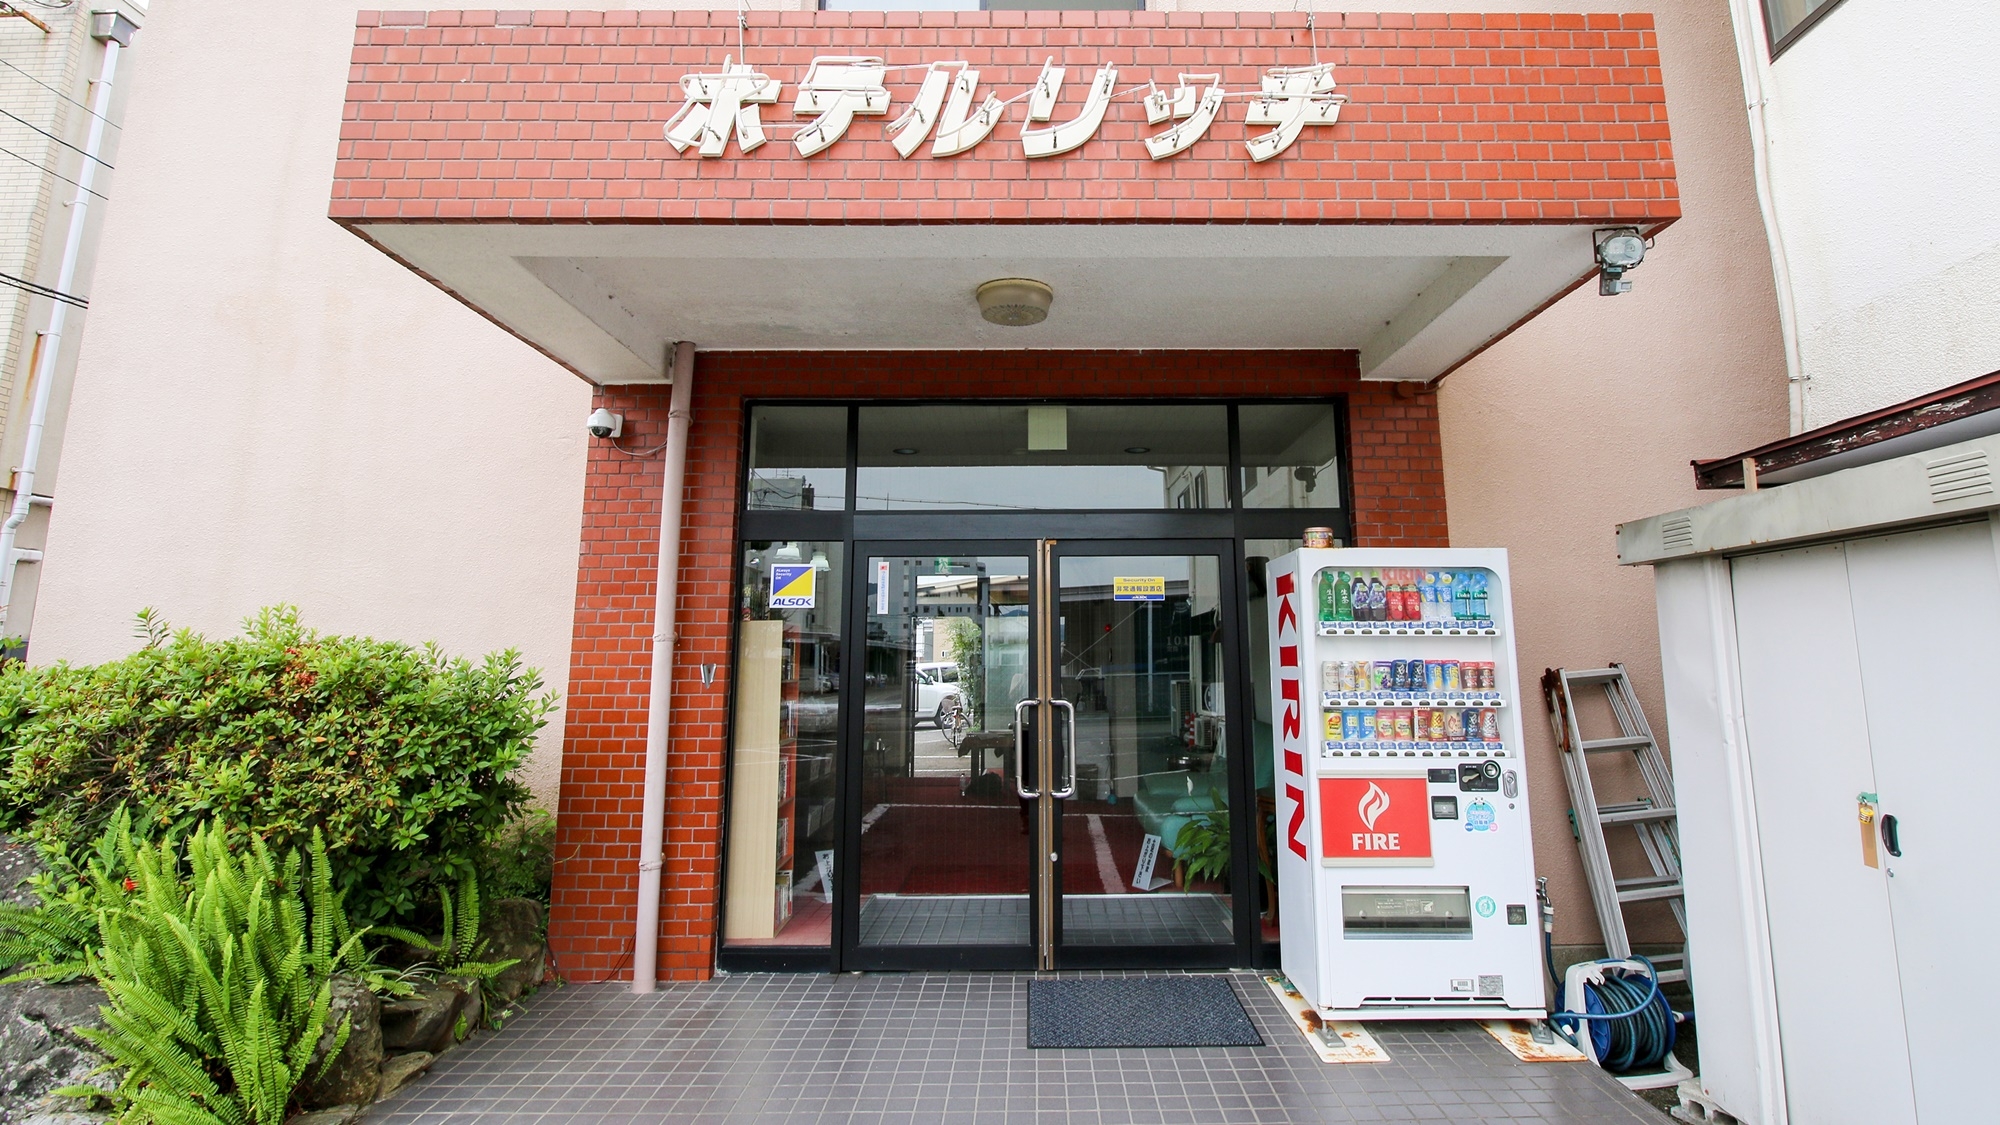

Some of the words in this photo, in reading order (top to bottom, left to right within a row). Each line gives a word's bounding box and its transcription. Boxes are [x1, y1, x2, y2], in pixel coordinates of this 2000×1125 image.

[664, 54, 1346, 161] ホテルリッチ
[1382, 569, 1425, 580] KIRIN
[773, 597, 812, 606] ALSOK
[1276, 571, 1307, 862] KIRIN
[1351, 832, 1401, 851] FIRE
